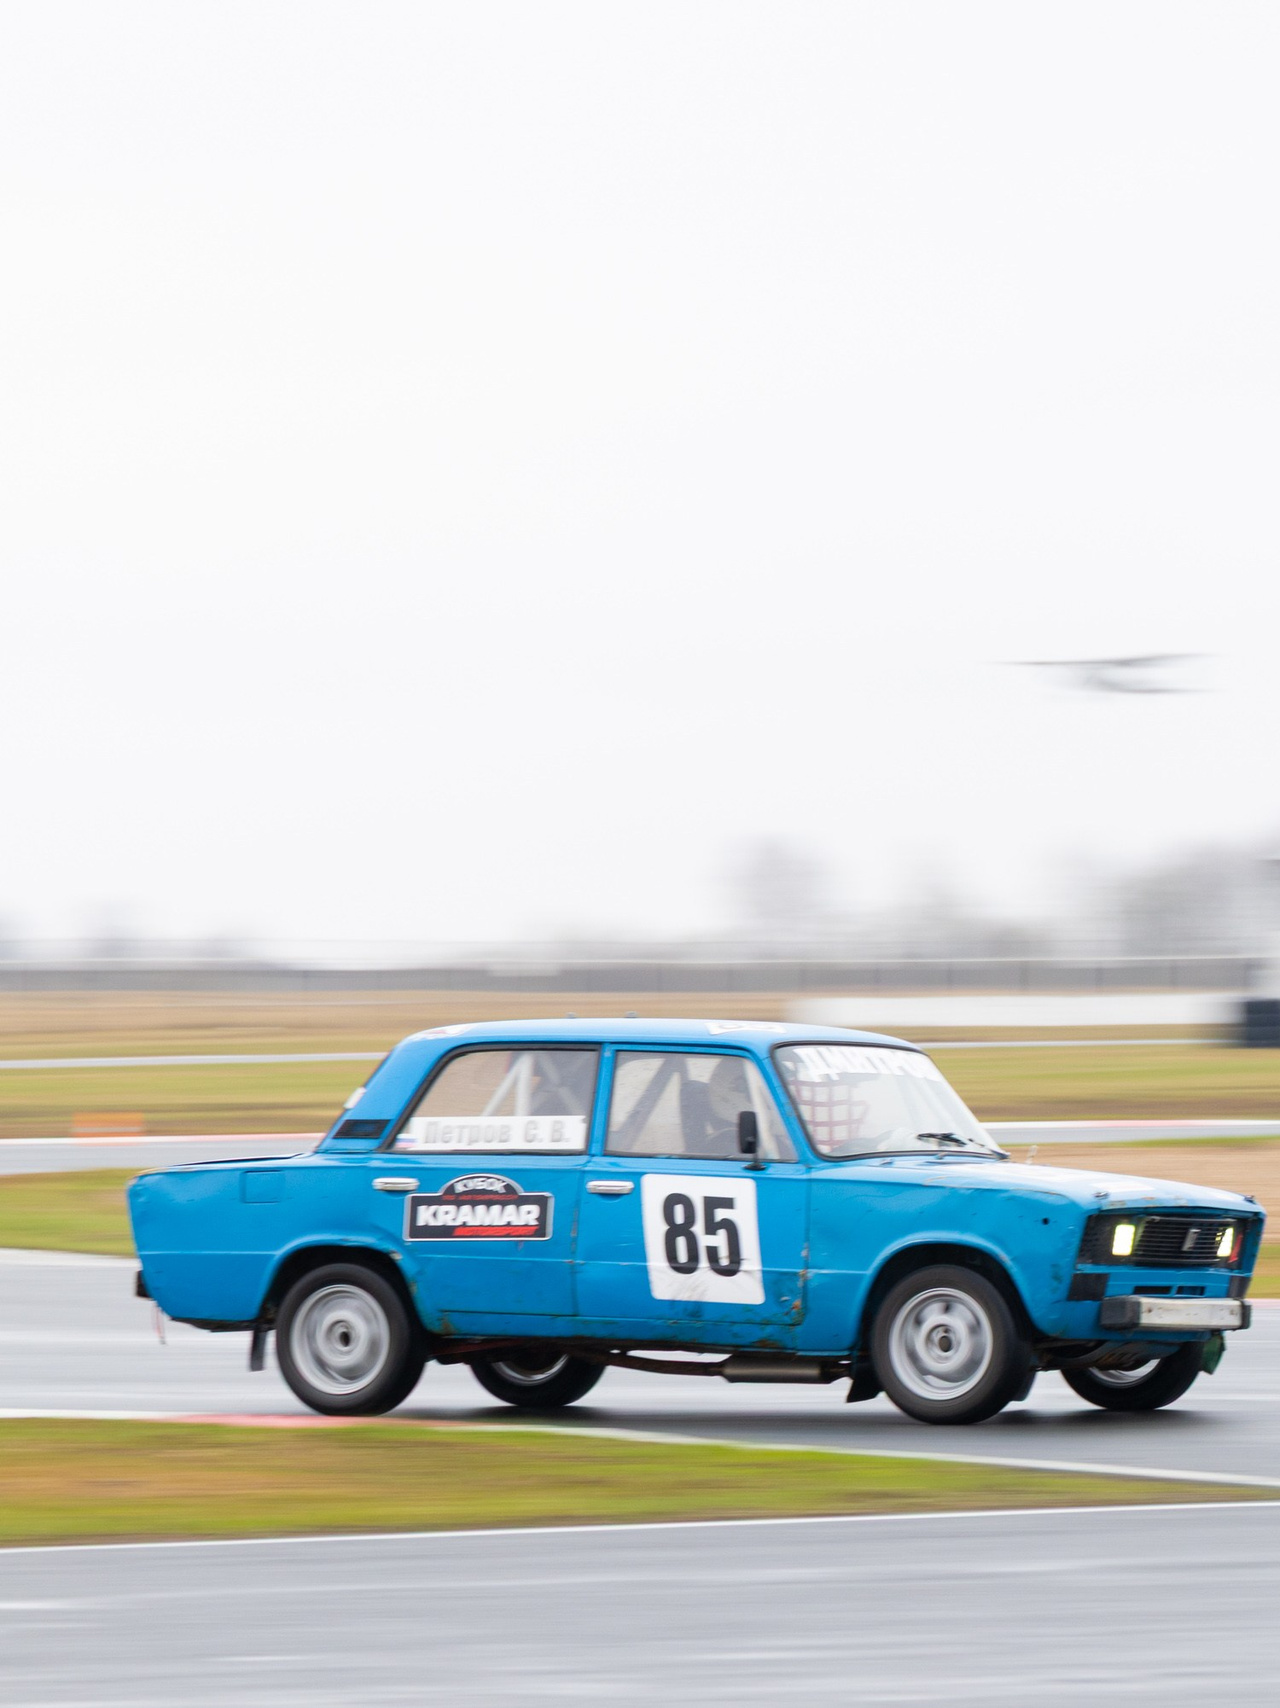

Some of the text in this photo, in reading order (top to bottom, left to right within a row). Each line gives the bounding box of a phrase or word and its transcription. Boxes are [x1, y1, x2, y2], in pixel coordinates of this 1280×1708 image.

[424, 1121, 510, 1145] Петров
[551, 1120, 571, 1143] В.
[416, 1204, 541, 1227] KRAMAR
[663, 1192, 742, 1278] 85
